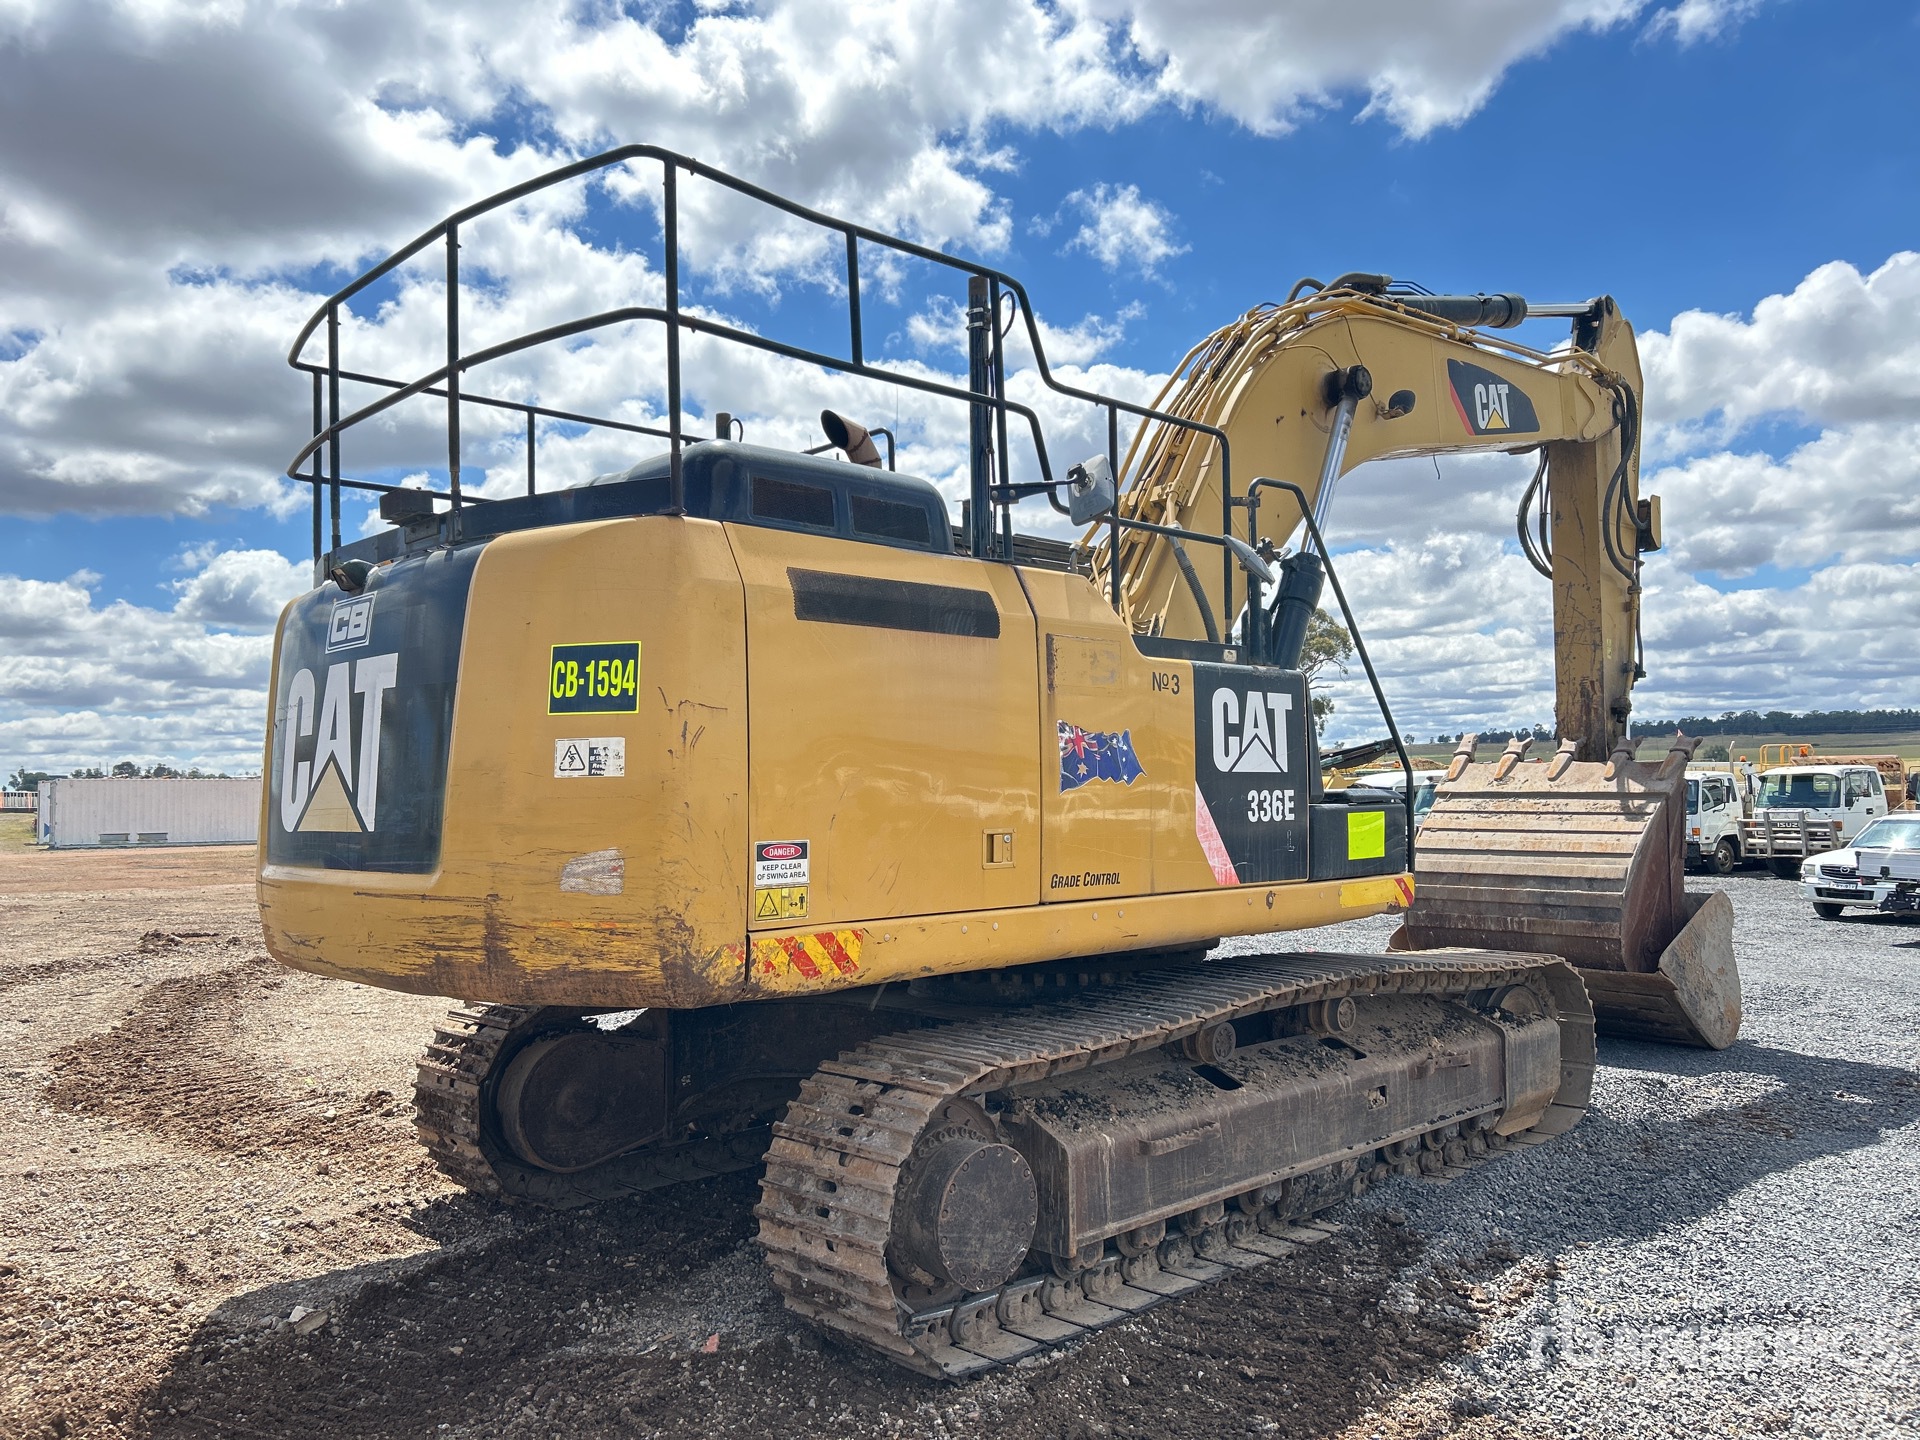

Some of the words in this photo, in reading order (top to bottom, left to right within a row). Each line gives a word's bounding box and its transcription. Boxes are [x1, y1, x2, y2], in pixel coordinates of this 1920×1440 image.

[1474, 383, 1510, 430] CAT
[330, 602, 370, 643] CB
[552, 659, 636, 698] CB-1594
[281, 652, 399, 833] CAT
[1211, 687, 1293, 773] CAT
[1247, 789, 1295, 823] 336E
[769, 847, 795, 857] DANGER
[767, 872, 788, 880] SWING
[1050, 873, 1081, 889] GRADE
[1083, 871, 1121, 887] CONTROL
